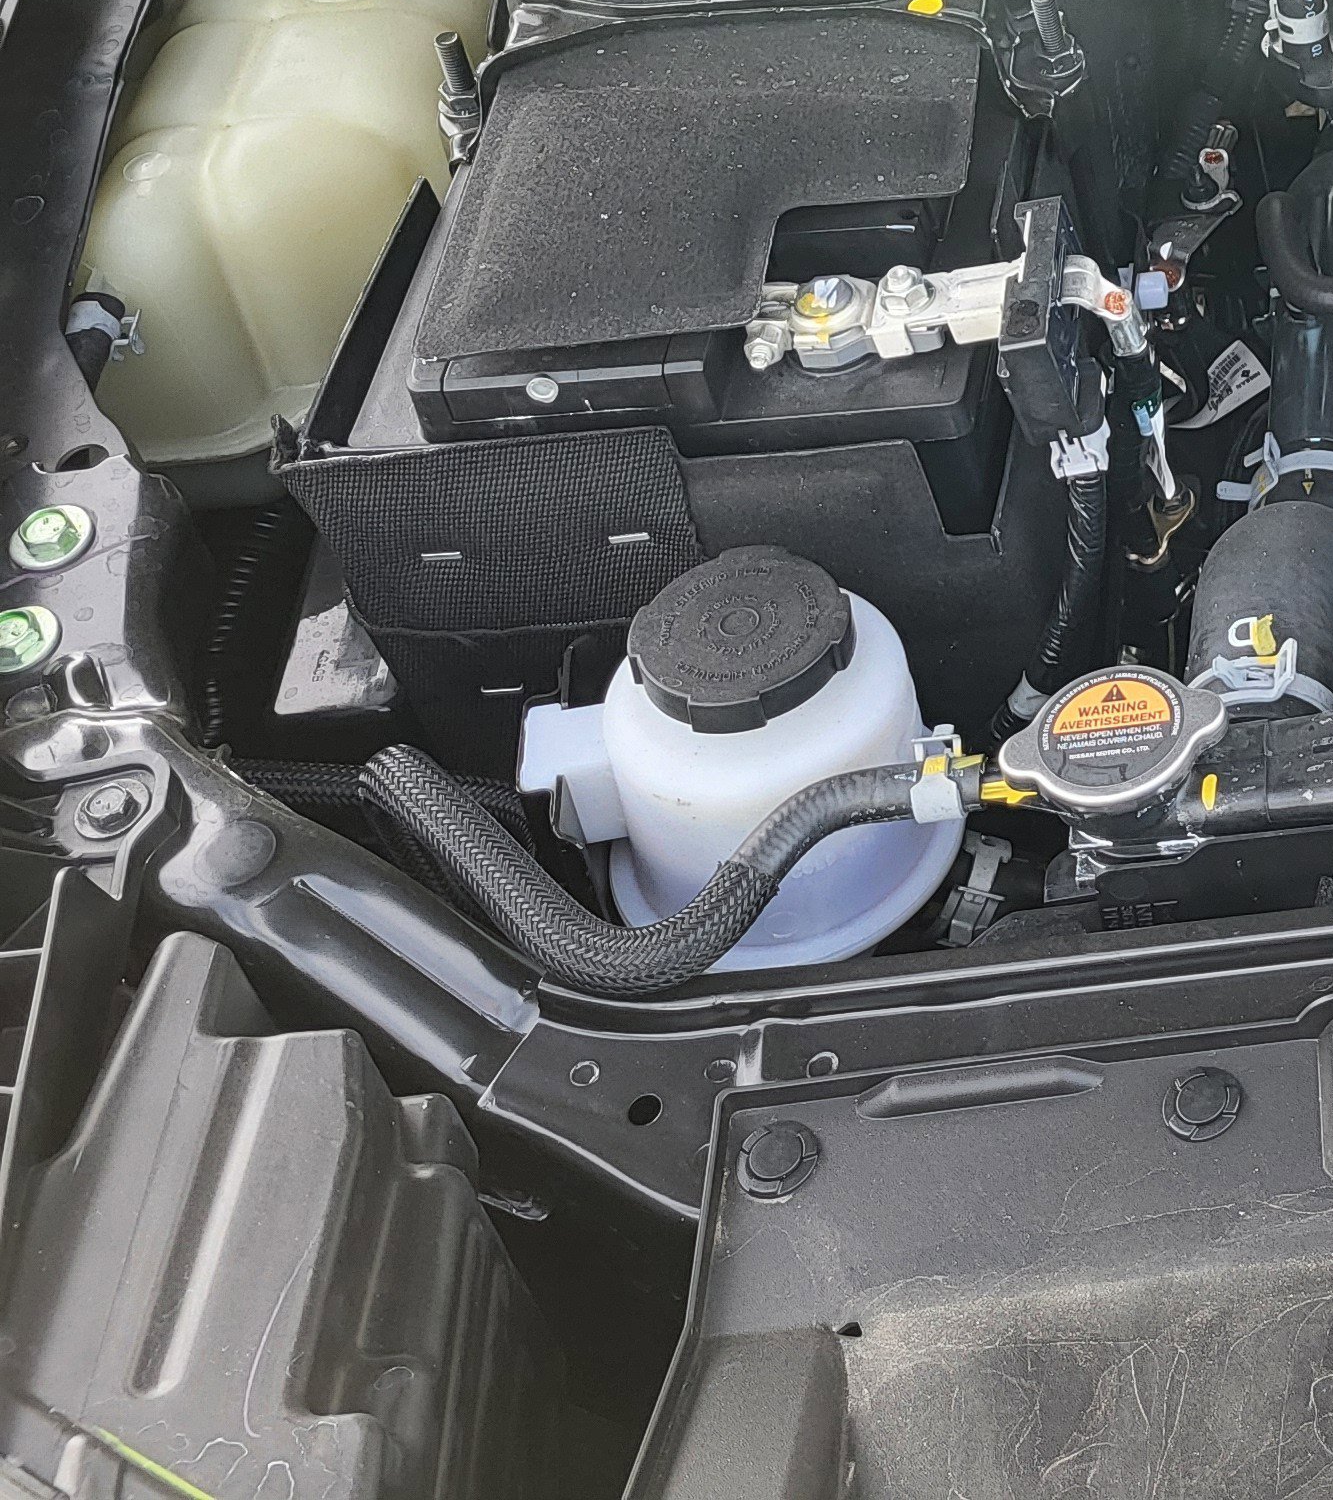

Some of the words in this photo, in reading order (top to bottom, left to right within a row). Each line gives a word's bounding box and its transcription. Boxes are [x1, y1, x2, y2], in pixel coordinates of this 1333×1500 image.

[1078, 700, 1148, 717] WARNING
[1060, 710, 1164, 730] AVERTISSEMENT
[1060, 732, 1087, 742] NEVER
[1089, 729, 1113, 739] OPEN
[1115, 726, 1141, 736] WHEN
[1143, 724, 1162, 732] HOT.
[1057, 742, 1068, 750] NE
[1069, 739, 1096, 749] JAMAIS
[1097, 736, 1127, 746] OUVRIR
[1069, 751, 1095, 760] NISSAN
[1096, 748, 1120, 757] MOTOR
